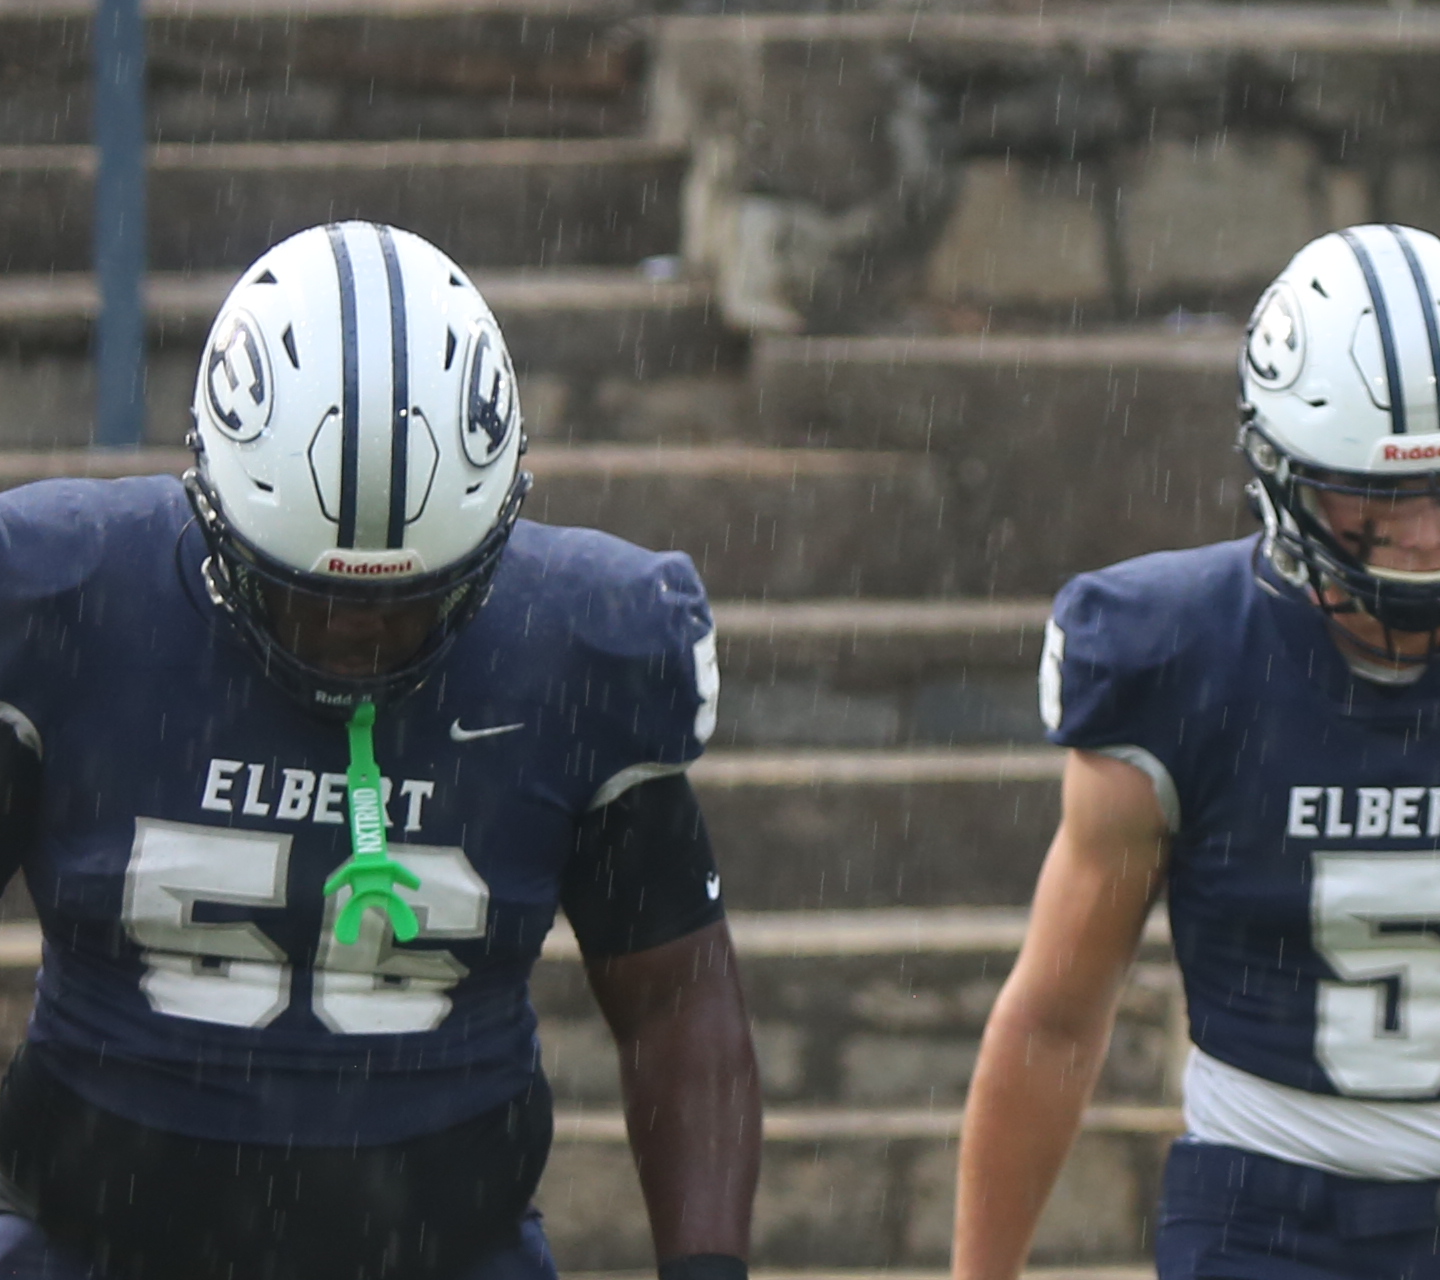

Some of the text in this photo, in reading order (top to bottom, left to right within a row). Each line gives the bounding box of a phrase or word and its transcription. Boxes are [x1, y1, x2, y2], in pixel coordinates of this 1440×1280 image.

[328, 557, 413, 575] Riddell
[315, 689, 373, 705] Riddll
[353, 787, 383, 854] NXTRND
[121, 816, 490, 1036] 56
